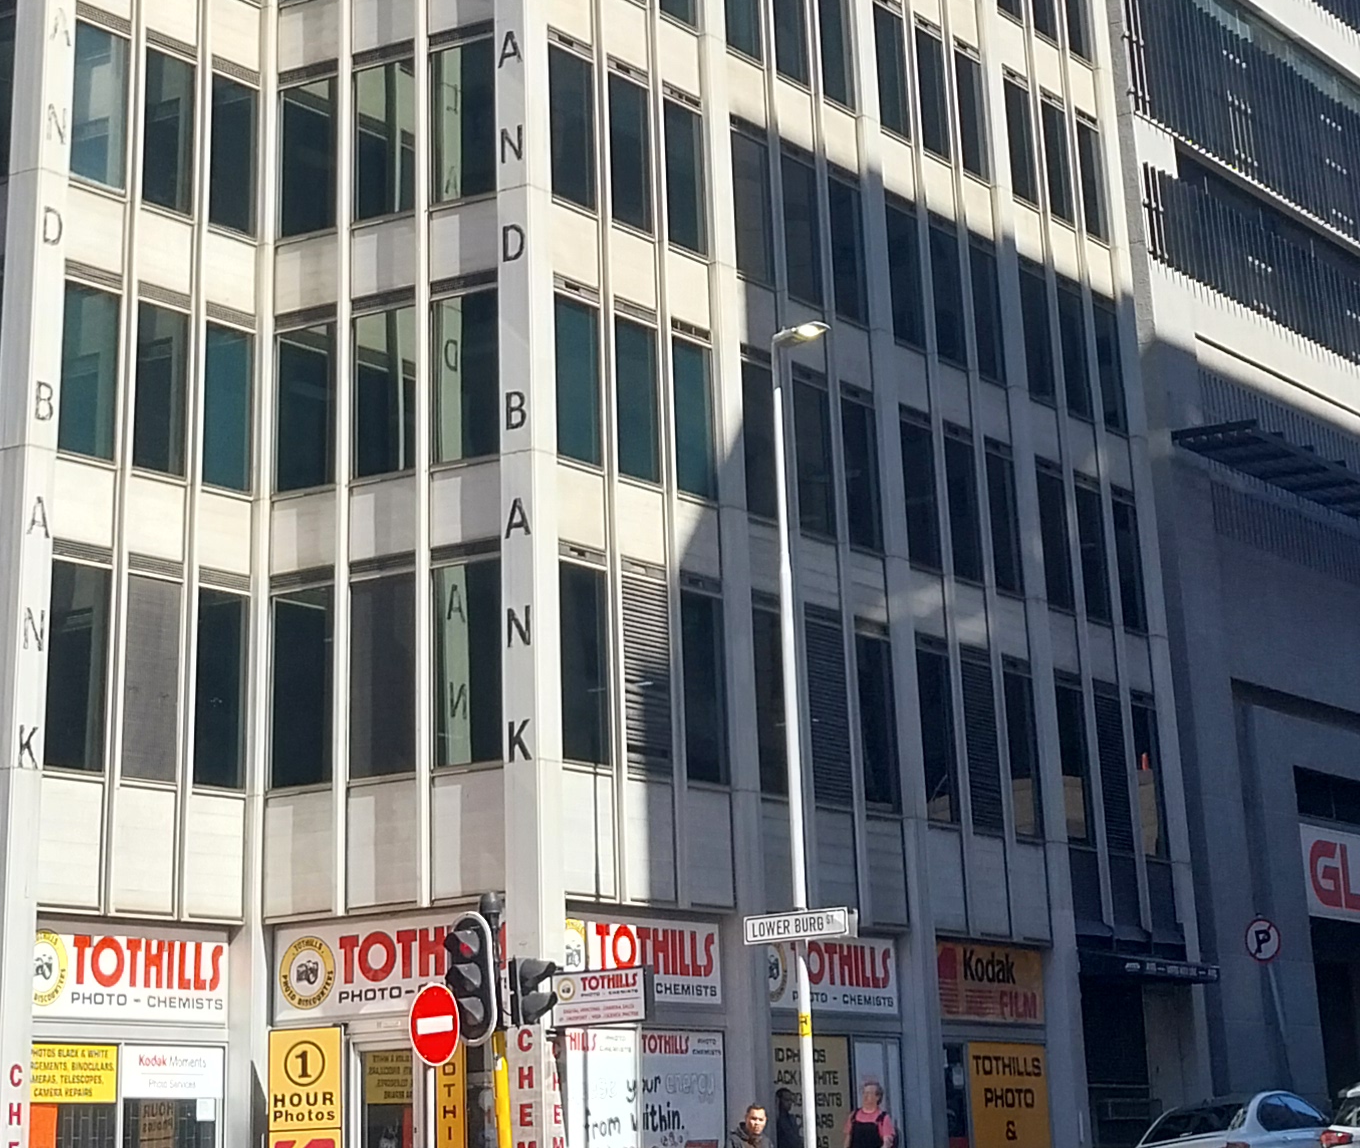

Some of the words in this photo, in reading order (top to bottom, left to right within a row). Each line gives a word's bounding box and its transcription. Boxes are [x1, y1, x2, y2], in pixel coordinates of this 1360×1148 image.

[17, 380, 55, 769] BANK
[503, 389, 533, 763] BANK
[752, 919, 790, 938] LOWER
[795, 915, 824, 933] BURG
[826, 914, 834, 925] ST
[595, 923, 715, 978] TOTHILLS
[1254, 929, 1271, 953] P
[73, 934, 224, 992] TOTHILLS
[963, 948, 1016, 984] Kodak
[580, 972, 638, 991] TOTHILLS
[655, 982, 717, 997] CHEMISTS
[71, 991, 128, 1007] PHOTO
[147, 995, 224, 1010] CHEMISTS
[842, 993, 894, 1007] CHEMISTS
[999, 990, 1037, 1020] FILM
[138, 1054, 167, 1067] Kodak
[169, 1055, 207, 1068] Moments
[295, 1050, 312, 1078] 1
[972, 1055, 1042, 1077] TOTHILLS
[148, 1079, 168, 1089] Photo
[273, 1091, 334, 1108] HOUR
[984, 1087, 1035, 1109] PHOTO
[273, 1109, 335, 1123] Photos
[1005, 1120, 1018, 1141] &
